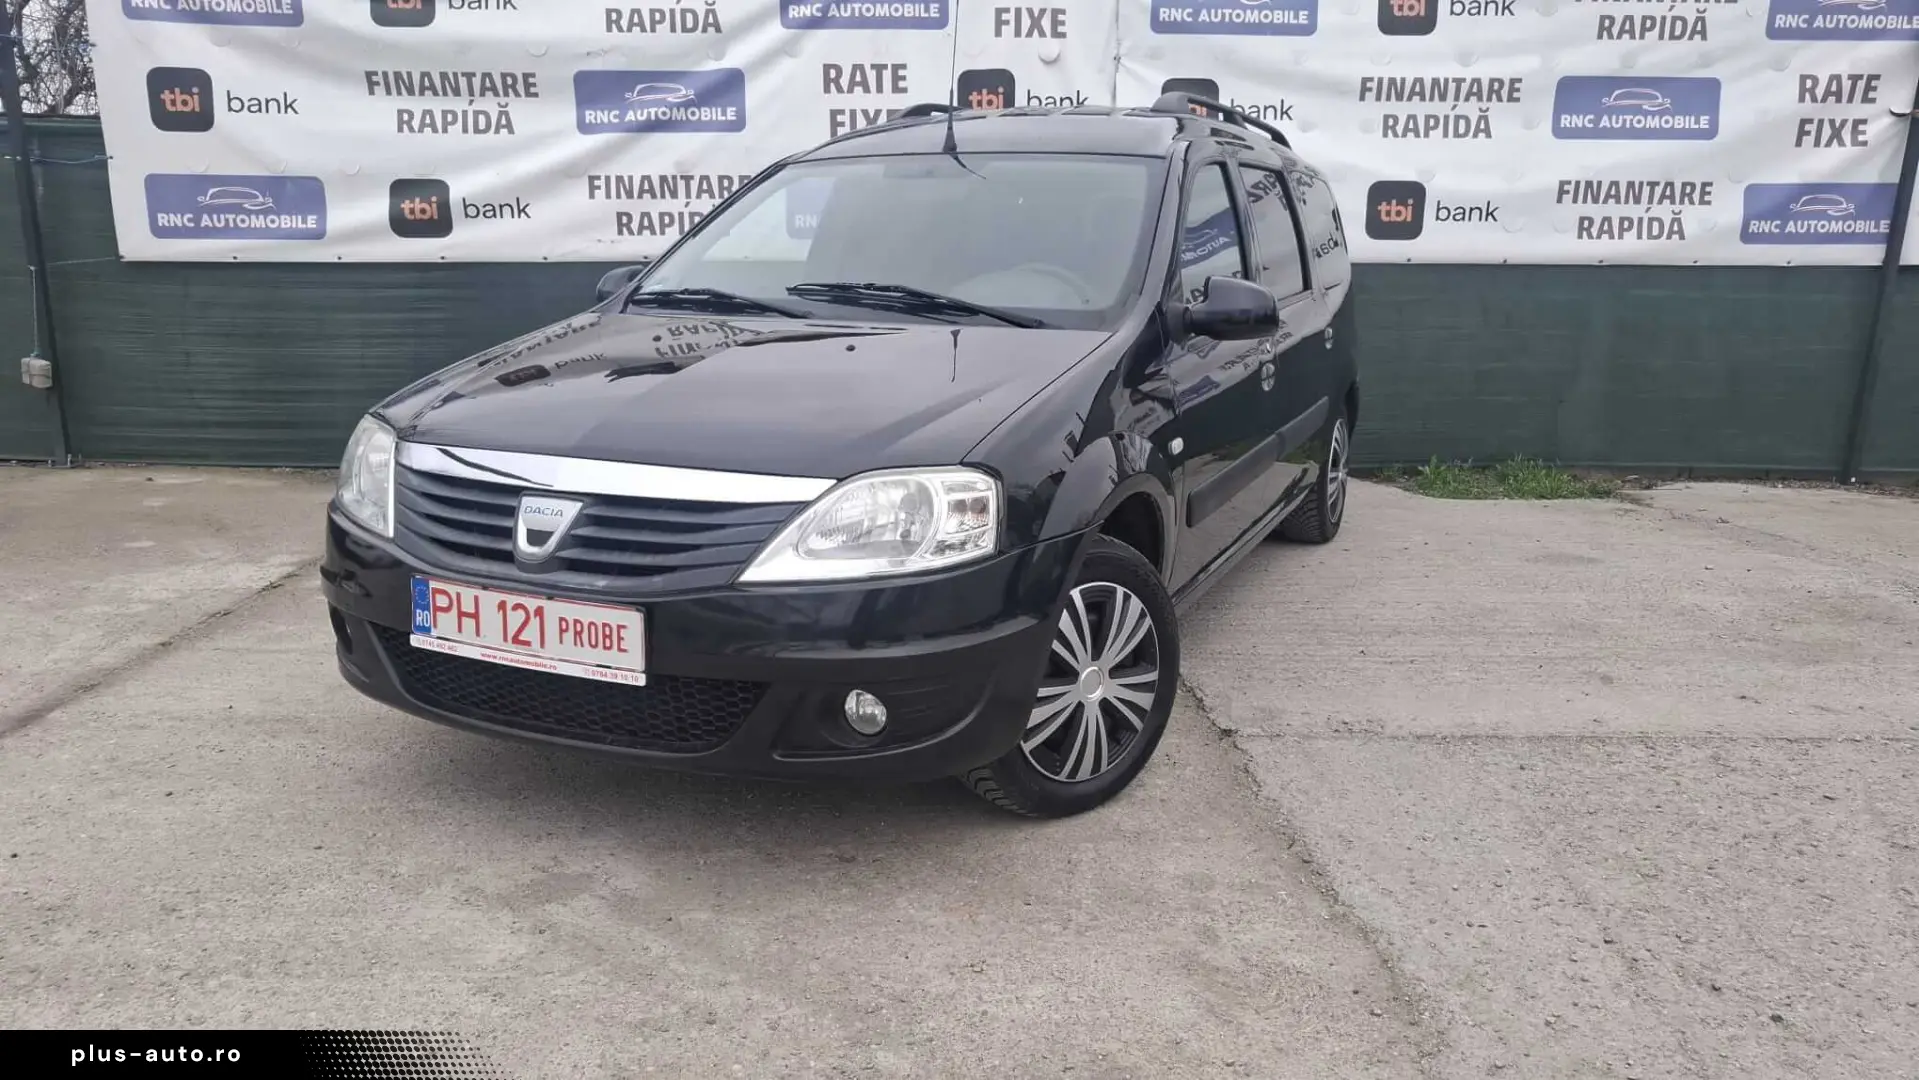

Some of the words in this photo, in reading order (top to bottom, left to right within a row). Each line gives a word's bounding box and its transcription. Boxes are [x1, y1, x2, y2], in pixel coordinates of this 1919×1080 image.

[177, 0, 294, 14] AUTOMOBILE
[788, 4, 823, 18] RNC
[828, 2, 940, 18] AUTOMOBILE
[1159, 8, 1193, 23] RNC
[1199, 8, 1309, 25] AUTOMOBILE
[1449, 0, 1516, 17] bank
[993, 7, 1068, 39] FIXE
[1774, 14, 1810, 28] RNC
[1813, 14, 1919, 29] AUTOMOBILE
[822, 63, 909, 94] RATE
[1798, 73, 1882, 104] RATE
[160, 87, 200, 113] tbi
[227, 91, 299, 115] bank
[968, 86, 1005, 111] tbi
[1027, 89, 1089, 107] bank
[585, 109, 620, 124] RNC
[625, 107, 738, 123] AUTOMOBILE
[1560, 114, 1595, 129] RNC
[1599, 115, 1710, 129] AUTOMOBILE
[1795, 118, 1869, 148] FIXE
[401, 196, 438, 220] tbi
[462, 197, 532, 219] bank
[1378, 199, 1413, 222] tbi
[1435, 200, 1500, 222] bank
[157, 213, 195, 228] RNC
[200, 213, 317, 229] AUTOMOBILE
[616, 211, 705, 237] RAPI
[794, 214, 820, 229] RN
[1748, 220, 1782, 233] RNC
[1785, 220, 1890, 234] AUTOMOBILE
[524, 505, 564, 517] DACIA
[416, 609, 430, 627] RO
[430, 586, 481, 638] PH
[496, 599, 546, 649] 121
[558, 616, 629, 653] PROBE
